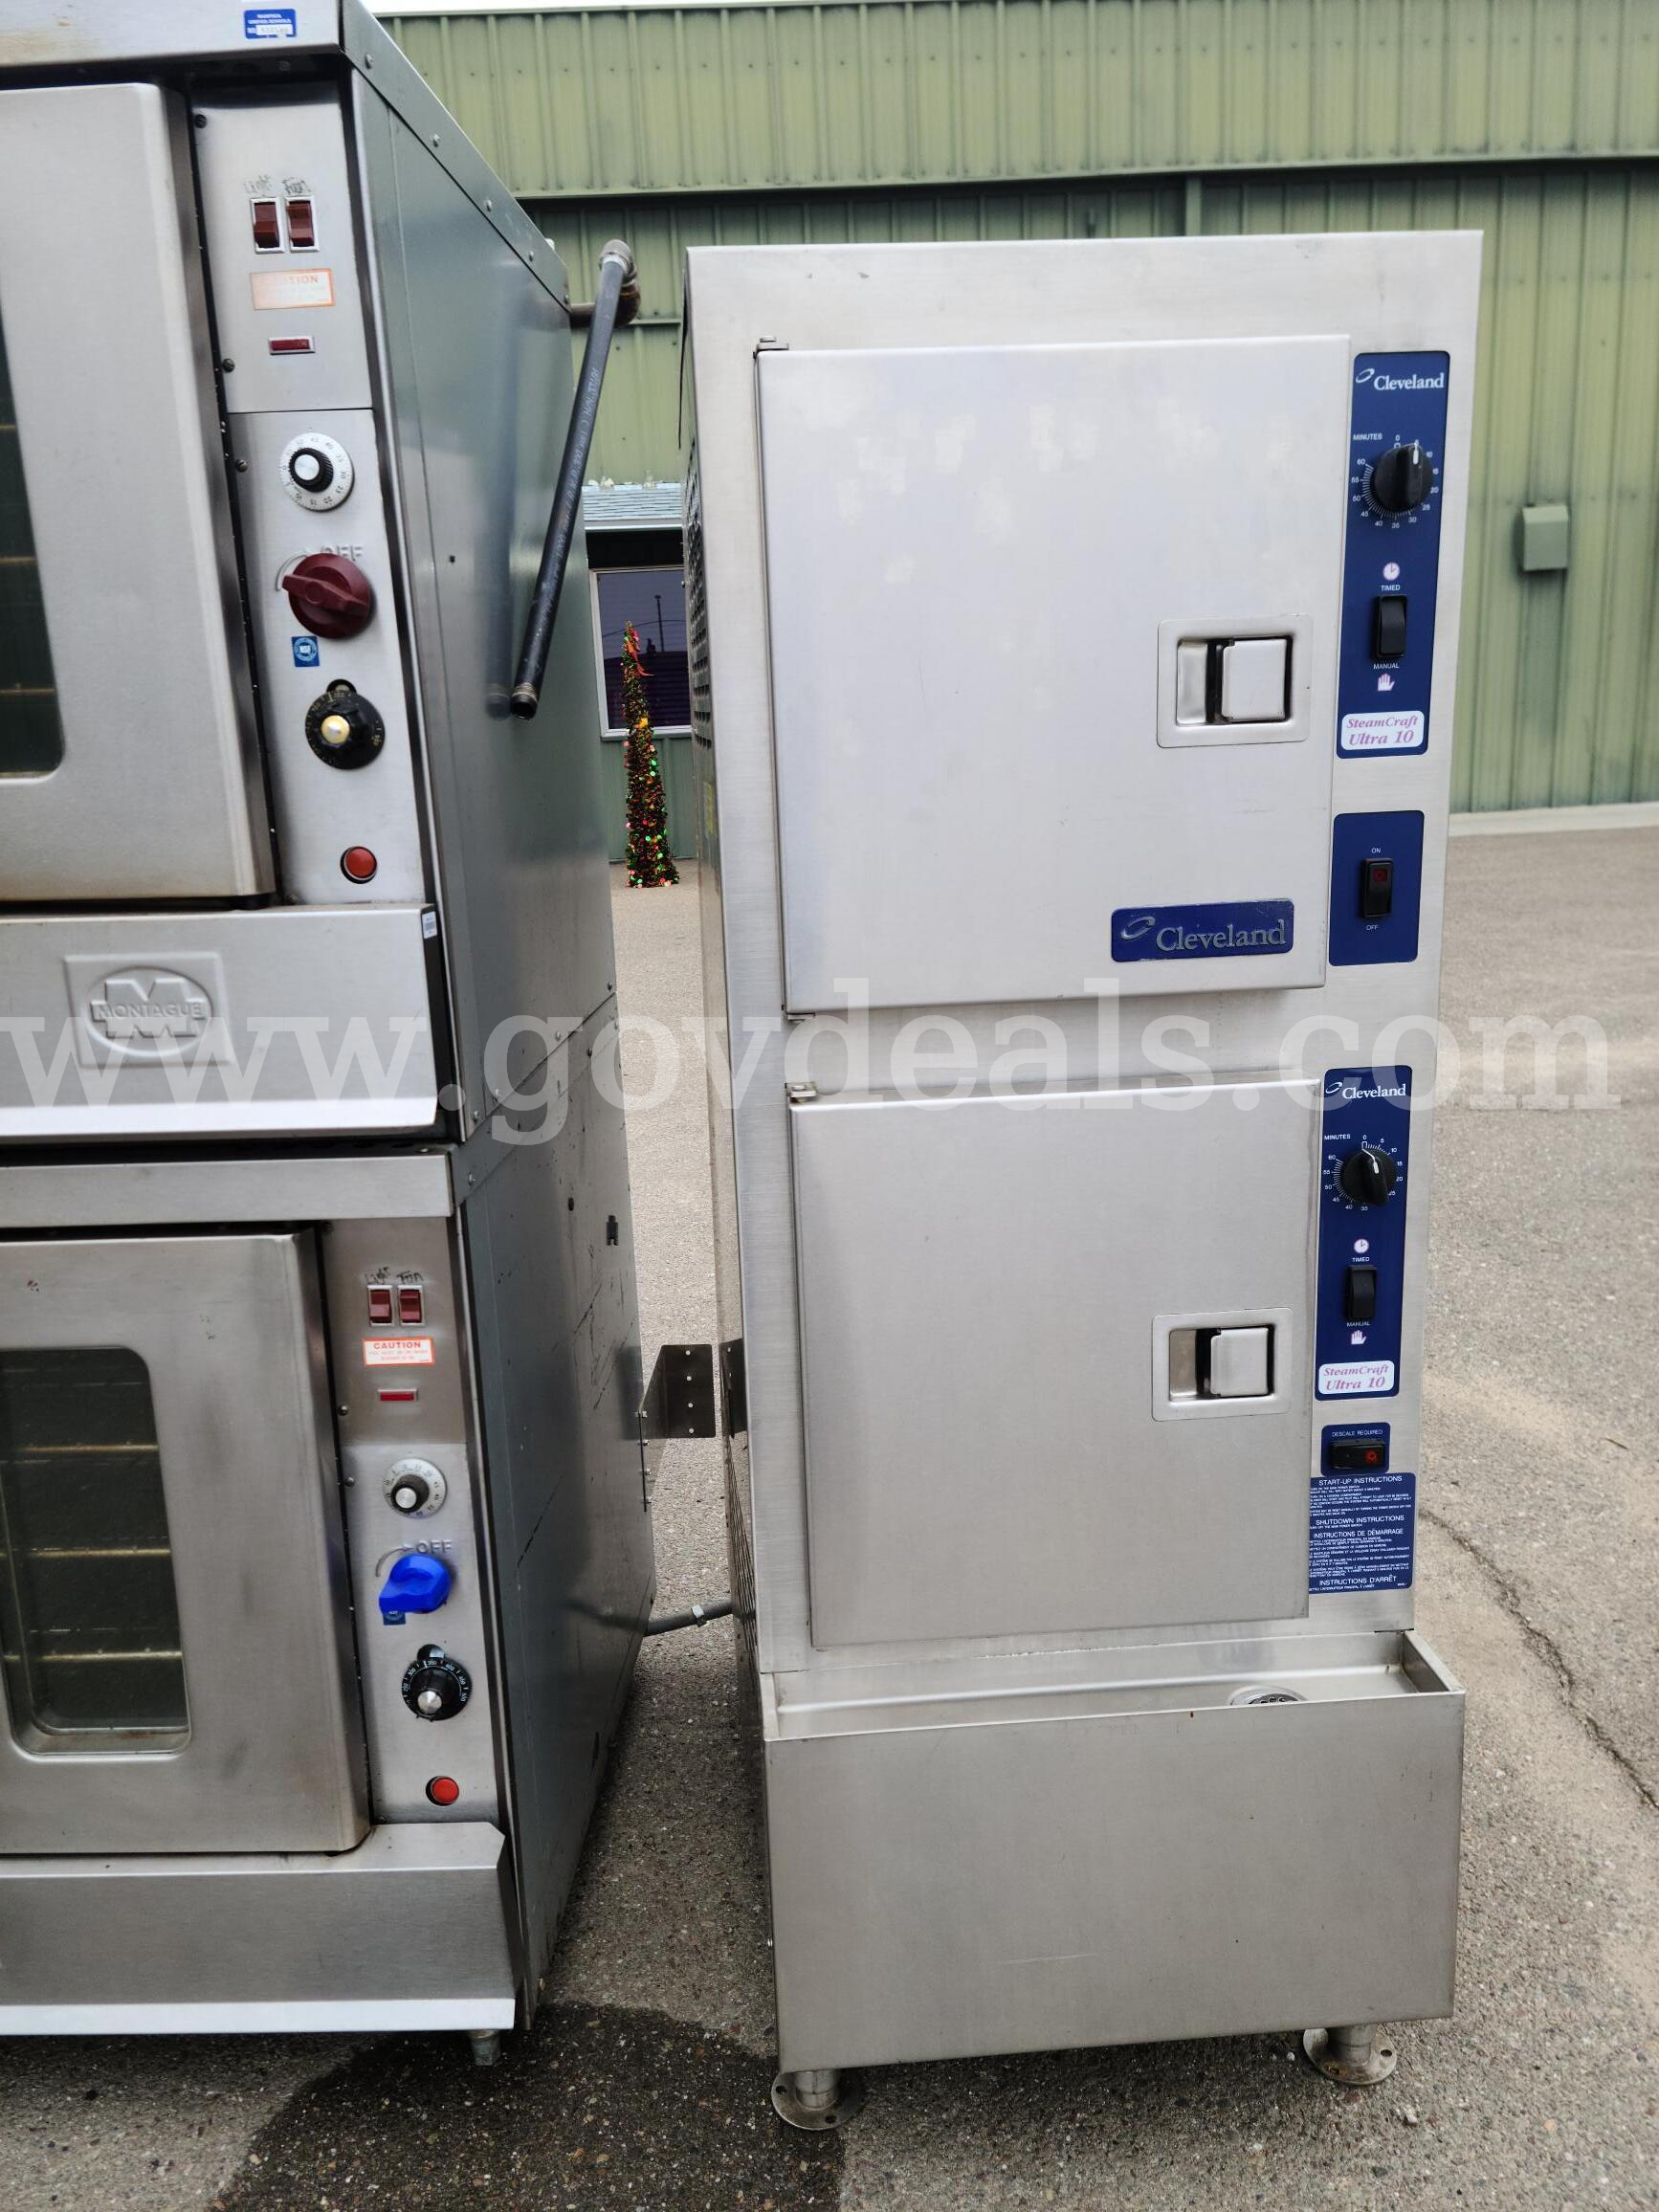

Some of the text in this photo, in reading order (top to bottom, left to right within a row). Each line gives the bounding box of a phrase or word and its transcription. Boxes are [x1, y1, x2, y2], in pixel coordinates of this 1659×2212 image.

[1374, 372, 1445, 390] Cleveland
[1346, 715, 1418, 729] SteamCraft
[1349, 730, 1414, 746] Ultra 10
[1156, 918, 1286, 952] Cleveland
[97, 1002, 203, 1019] MONTAGUE
[1342, 1084, 1406, 1099] Cleveland
[373, 1341, 421, 1350] CAUTION
[1323, 1363, 1388, 1377] SteamCraft
[1325, 1376, 1385, 1391] Ultra 10
[1354, 1475, 1403, 1484] INSTRUCTIONS
[416, 1539, 453, 1555] OFF
[1319, 1578, 1367, 1586] INSTRUCTIONS
